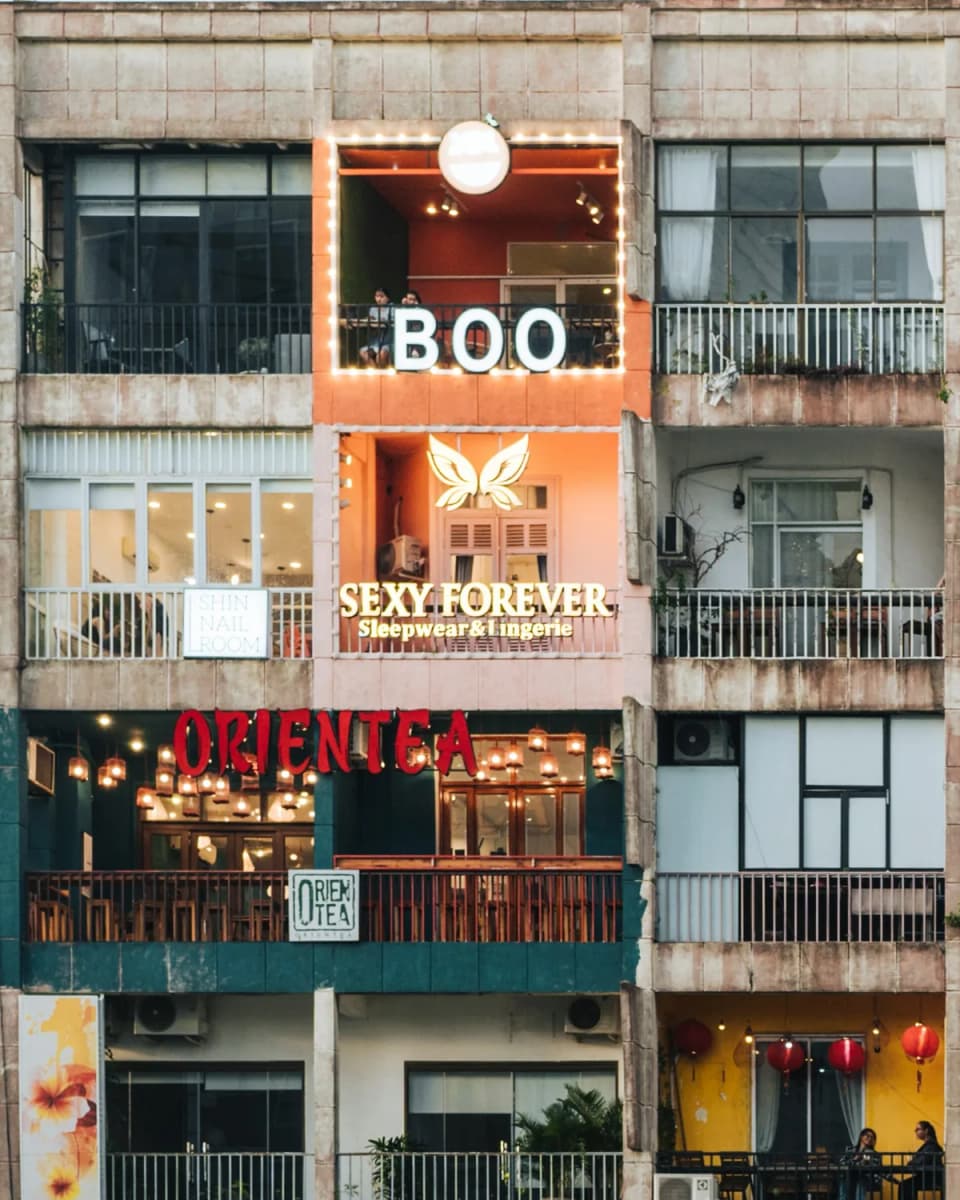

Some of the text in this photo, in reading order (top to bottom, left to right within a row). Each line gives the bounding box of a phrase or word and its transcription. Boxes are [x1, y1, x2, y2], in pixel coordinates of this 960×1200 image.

[394, 307, 567, 373] BOO
[200, 594, 249, 611] SHIN
[339, 582, 613, 618] SEXY FOREVER
[200, 615, 249, 633] NAIL
[200, 636, 260, 653] ROOM
[172, 708, 479, 777] ORIENTEA
